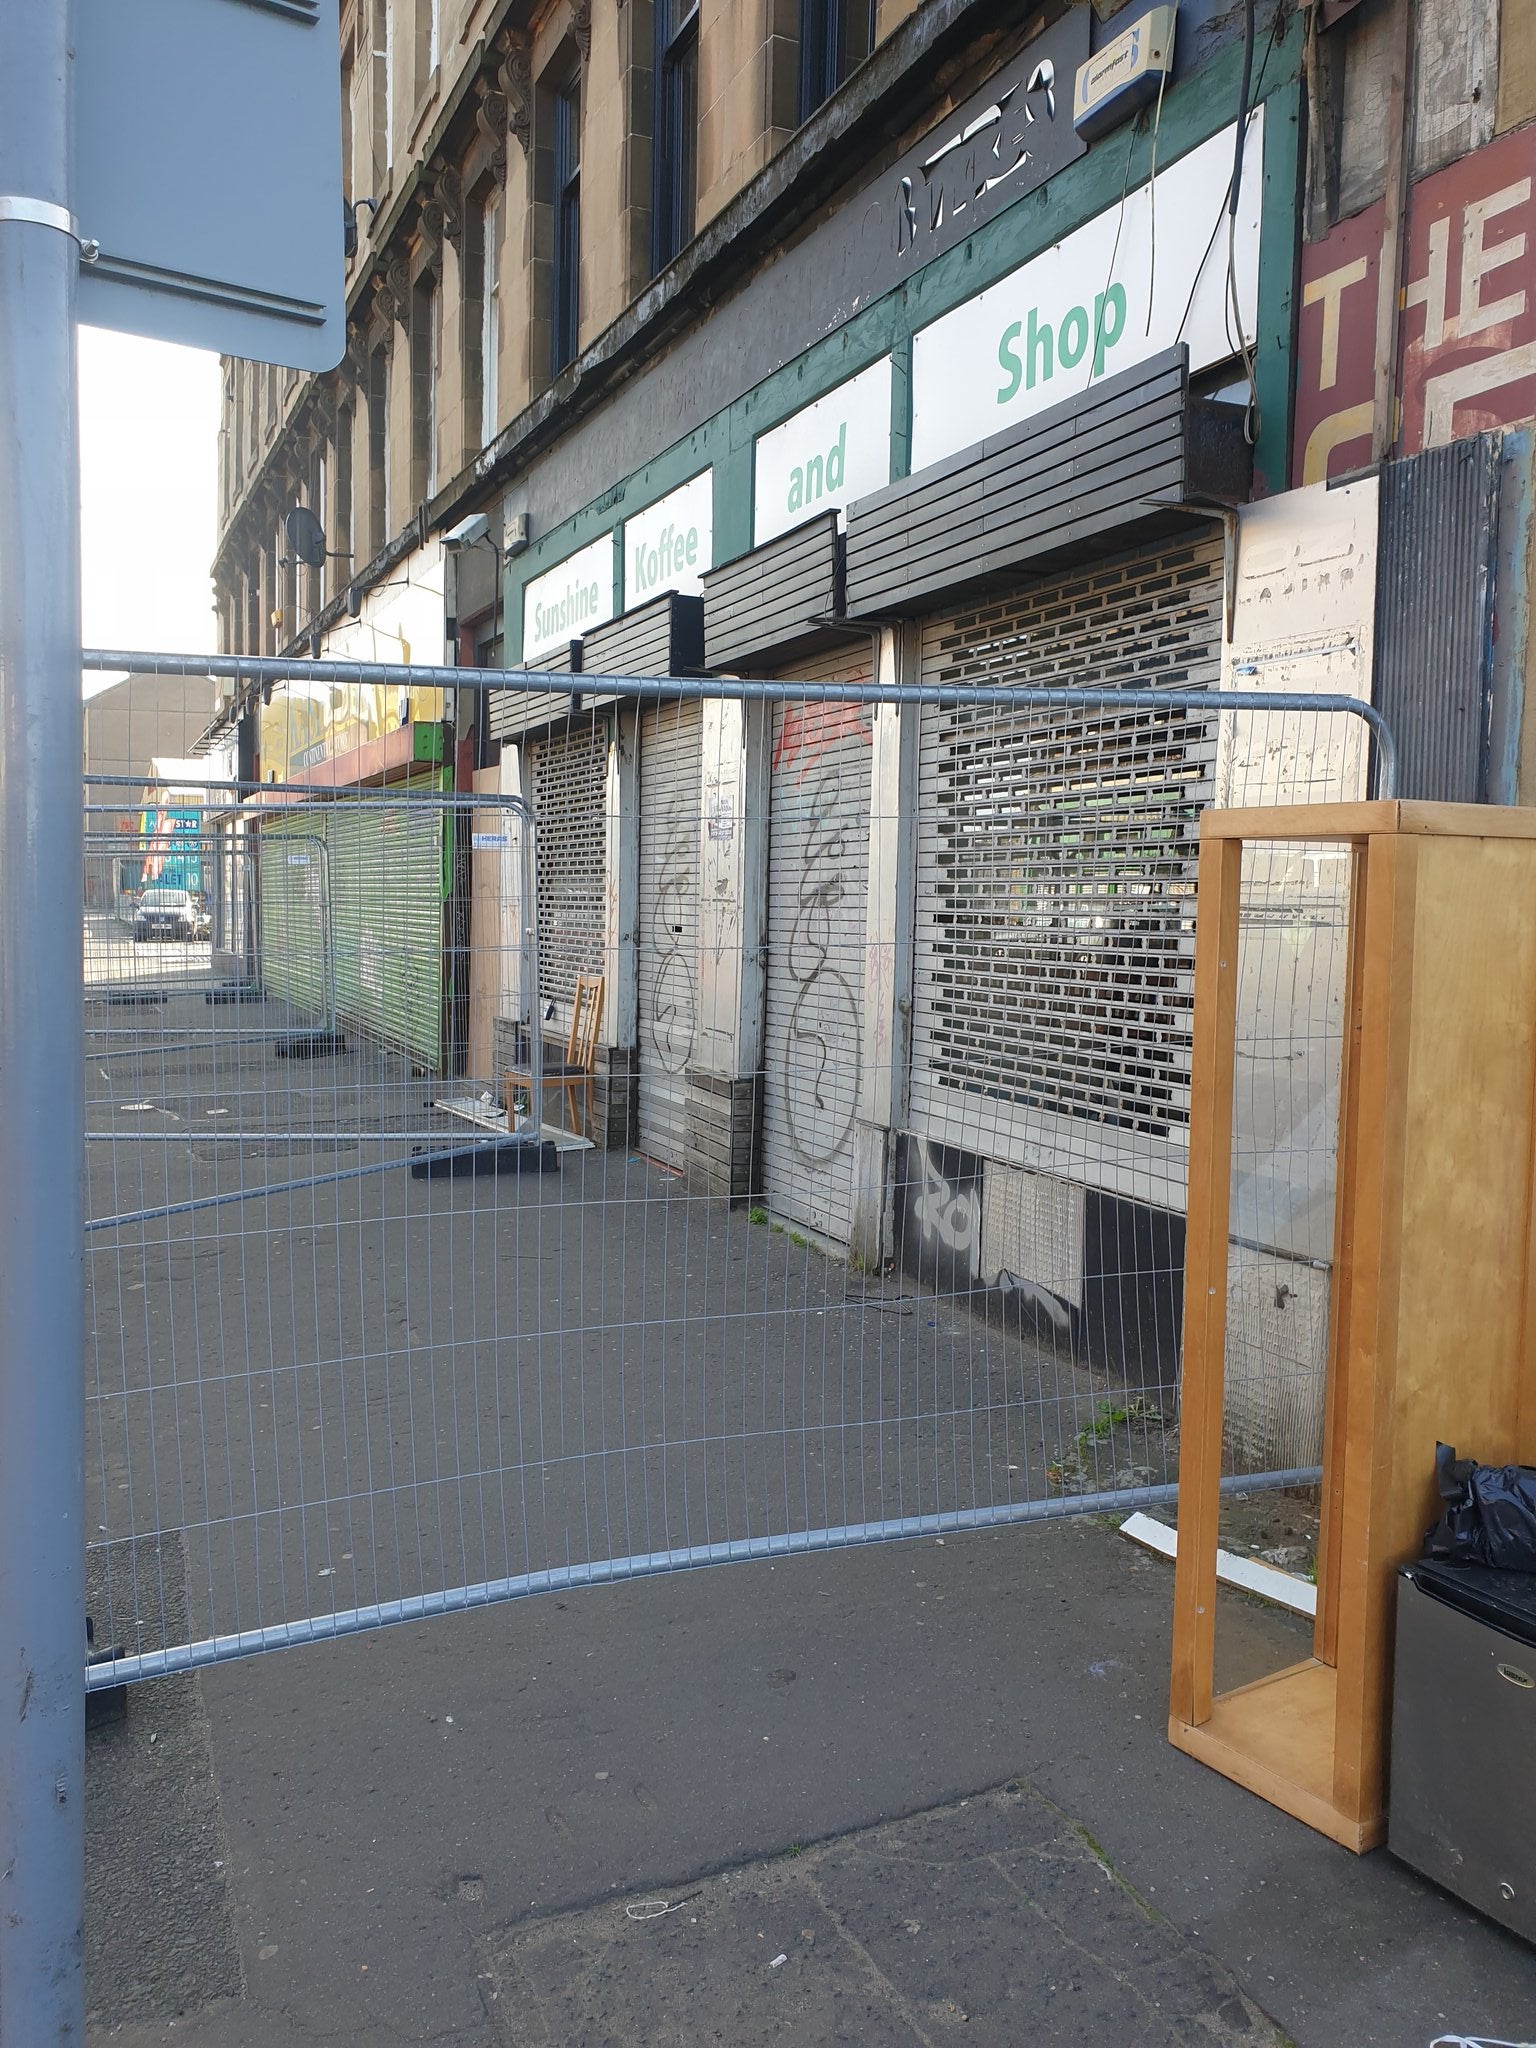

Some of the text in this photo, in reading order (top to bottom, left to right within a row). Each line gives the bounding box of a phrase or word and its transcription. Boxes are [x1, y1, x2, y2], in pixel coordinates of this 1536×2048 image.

[535, 282, 1127, 643] Sunshine Koffee and Shop
